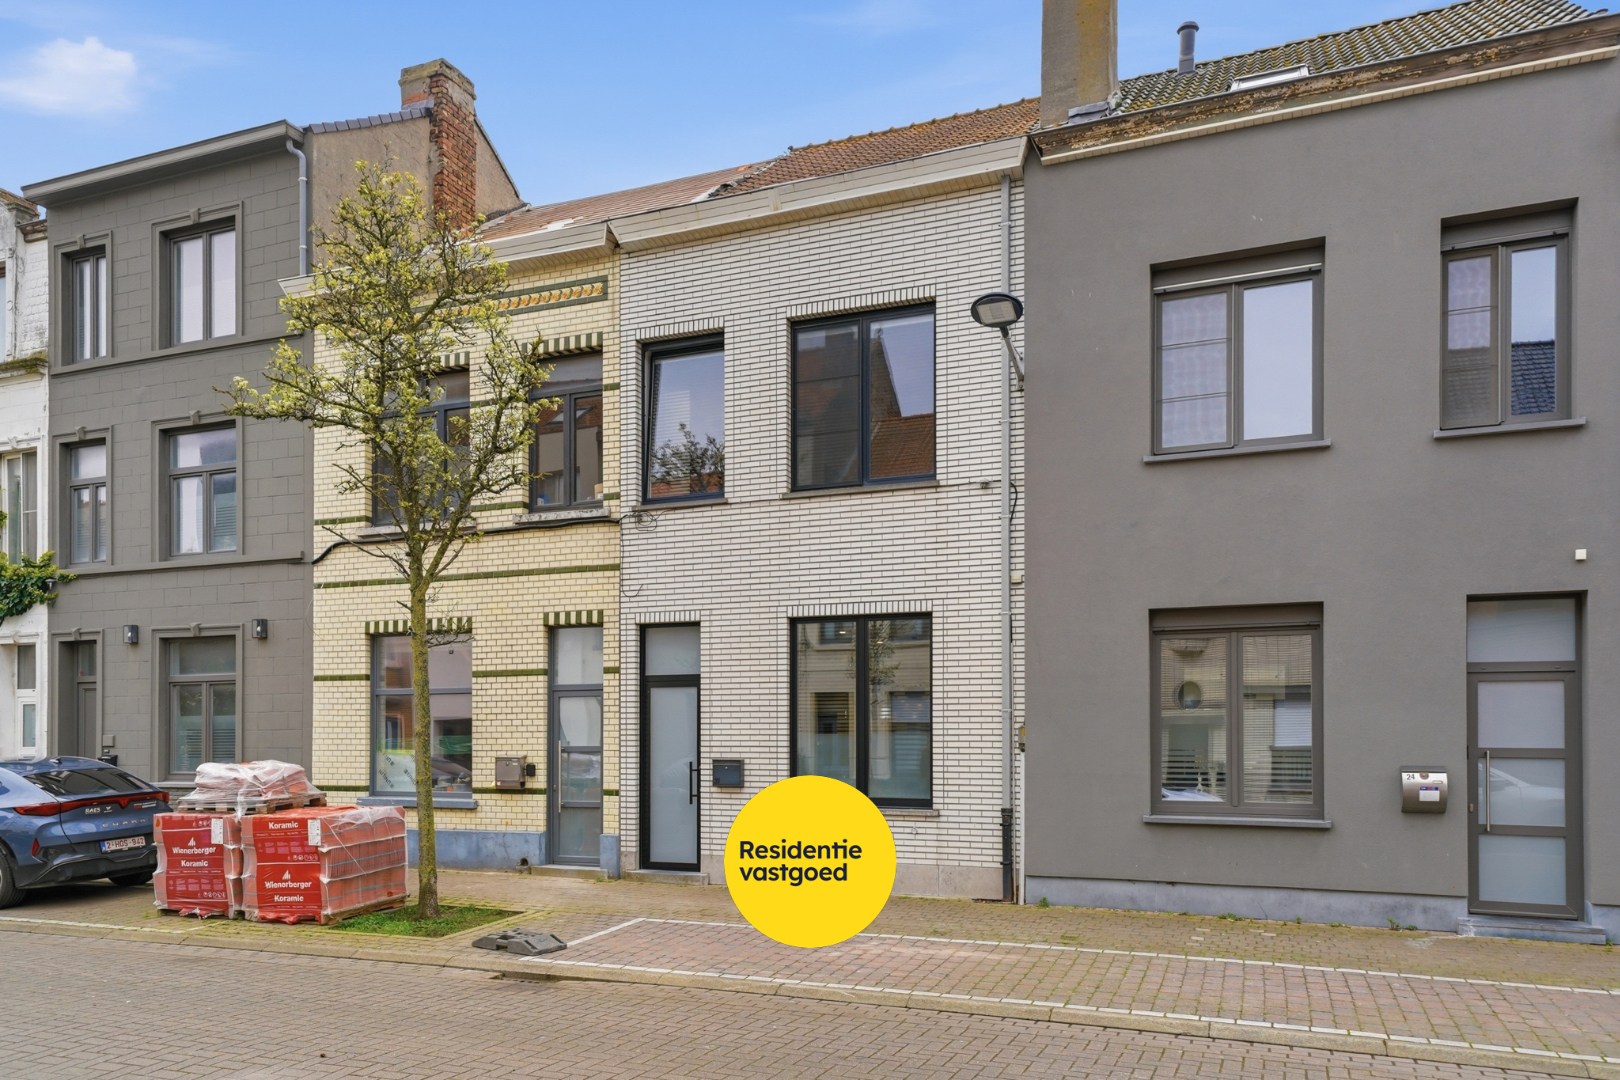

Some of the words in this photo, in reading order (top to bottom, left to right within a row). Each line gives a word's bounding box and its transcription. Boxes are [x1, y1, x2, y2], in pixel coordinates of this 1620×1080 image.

[268, 821, 299, 830] Koramic
[171, 846, 217, 855] Wienerberger
[181, 859, 209, 868] Koramic
[264, 881, 313, 890] Wienerberger
[274, 894, 304, 902] Koramic
